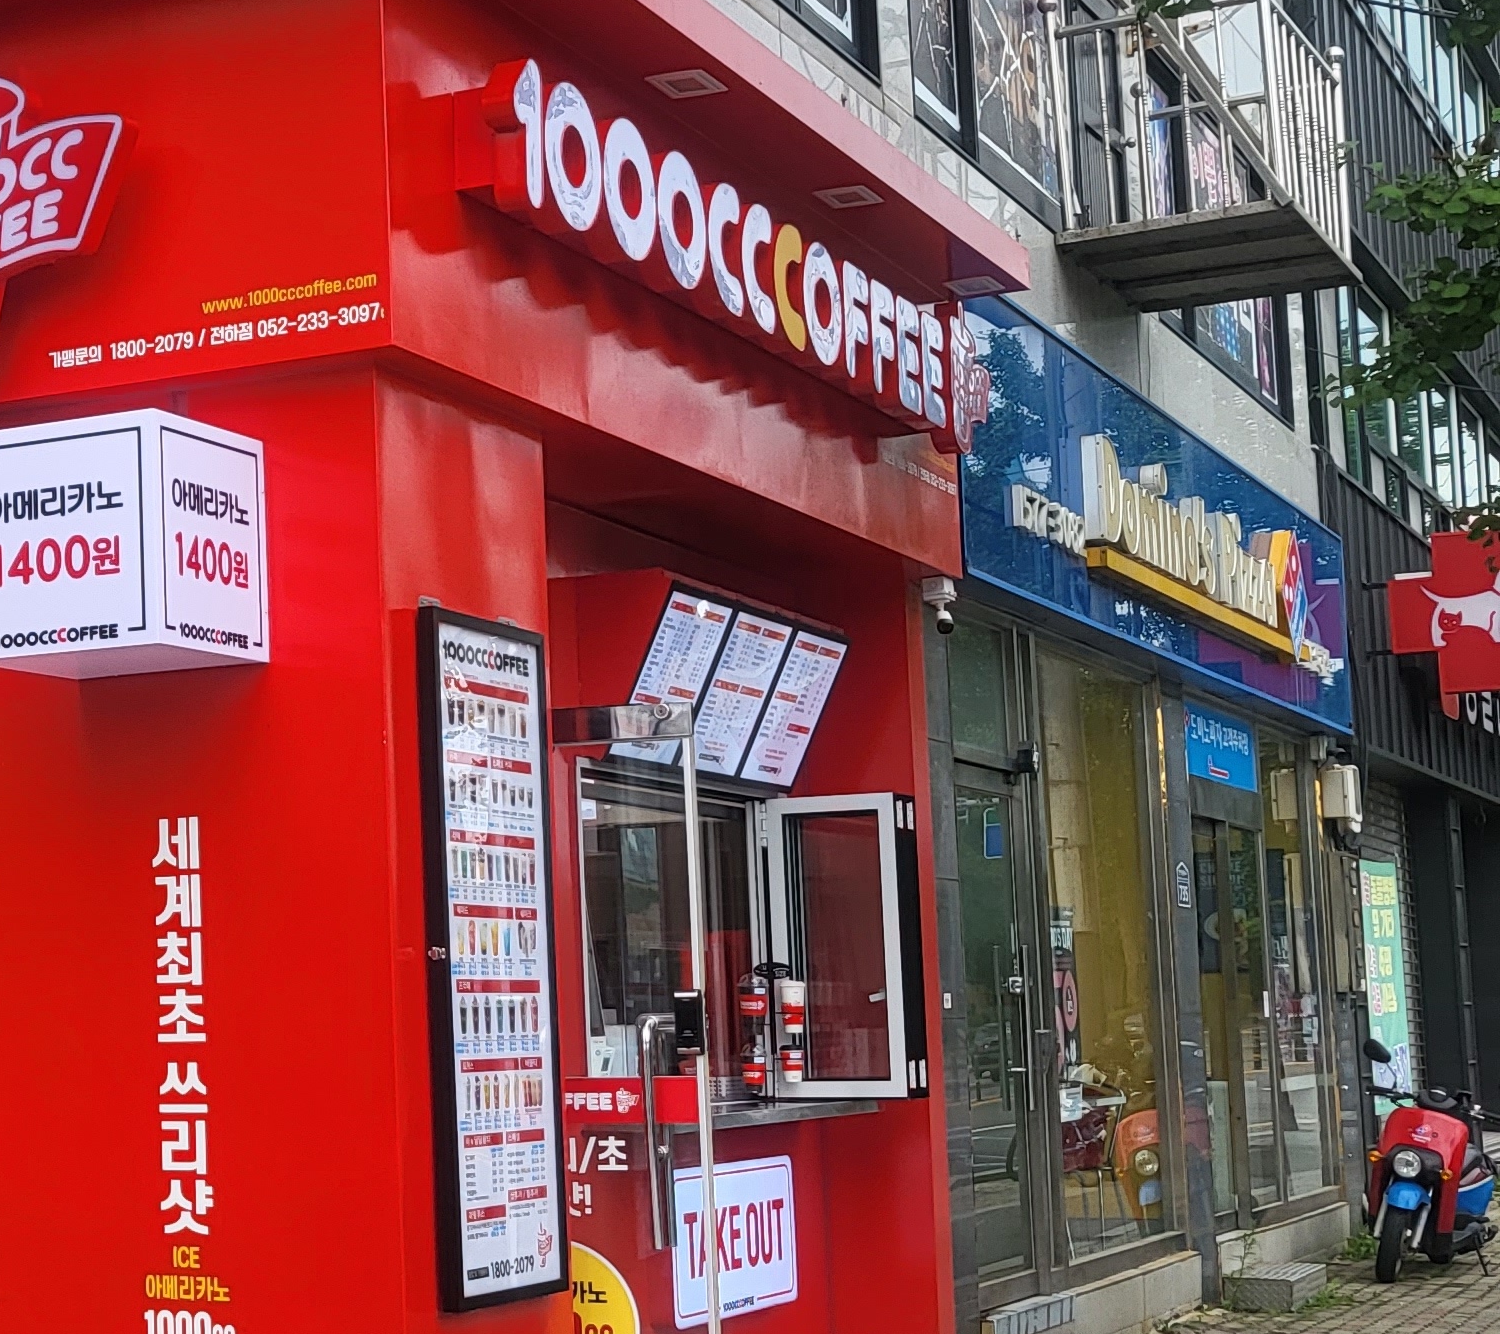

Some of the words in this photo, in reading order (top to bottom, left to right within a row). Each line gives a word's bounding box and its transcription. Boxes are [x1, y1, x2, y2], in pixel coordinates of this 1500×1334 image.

[201, 273, 378, 315] www.1000cccoffee.com
[48, 344, 103, 369] 가맹문의
[109, 331, 195, 361] 1800-2079
[209, 322, 254, 347] 전하점
[256, 301, 382, 340] 052-233-3097
[171, 477, 251, 527] 아메리카노
[174, 531, 250, 590] 1400원
[151, 816, 207, 1044] 세계최초
[158, 1061, 213, 1236] 쓰리샷
[172, 1245, 201, 1270] ICE
[745, 1198, 784, 1268] OUT
[145, 1274, 231, 1303] 아메리카노
[490, 1254, 535, 1279] 1800-2079
